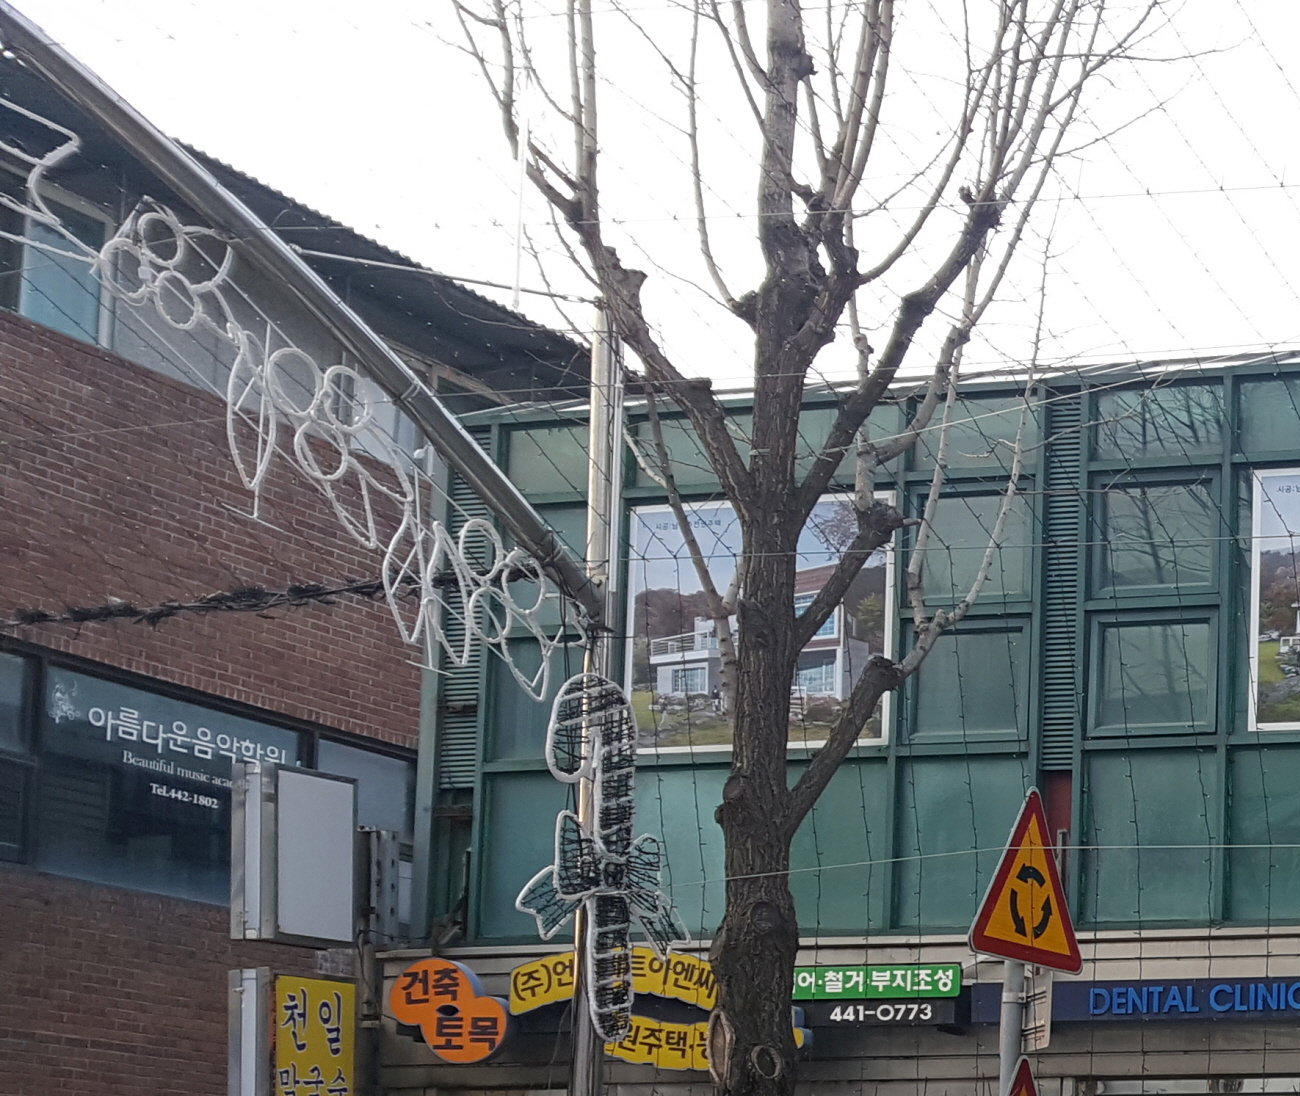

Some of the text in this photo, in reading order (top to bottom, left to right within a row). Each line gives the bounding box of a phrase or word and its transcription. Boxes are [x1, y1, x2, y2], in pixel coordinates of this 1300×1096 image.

[123, 750, 174, 775] Beautiful
[177, 765, 210, 783] music
[401, 968, 461, 1006] 건축
[1090, 985, 1200, 1015] DENTAL
[281, 987, 343, 1057] 천일
[830, 1003, 933, 1022] 441-0773
[433, 1016, 499, 1052] 토목
